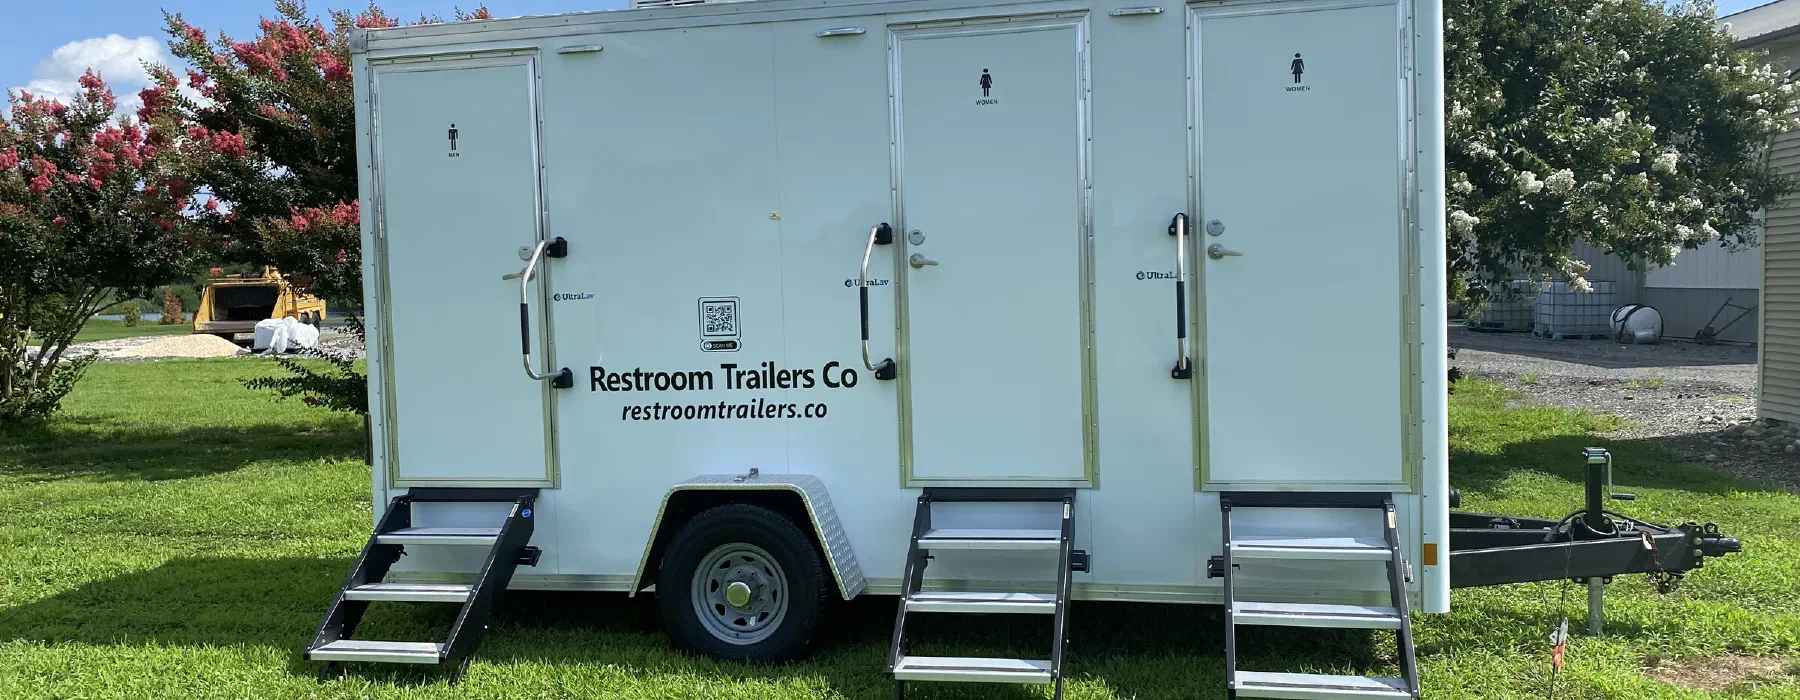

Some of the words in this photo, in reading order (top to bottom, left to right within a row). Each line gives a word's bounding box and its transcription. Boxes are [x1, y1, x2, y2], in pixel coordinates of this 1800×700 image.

[1146, 271, 1186, 280] UltraL
[853, 279, 889, 287] UraLav
[562, 292, 595, 301] UltraLav
[589, 365, 714, 392] Restroom
[720, 360, 816, 390] Trailers
[822, 360, 859, 388] Co
[621, 397, 828, 421] restroomtrailers.co
